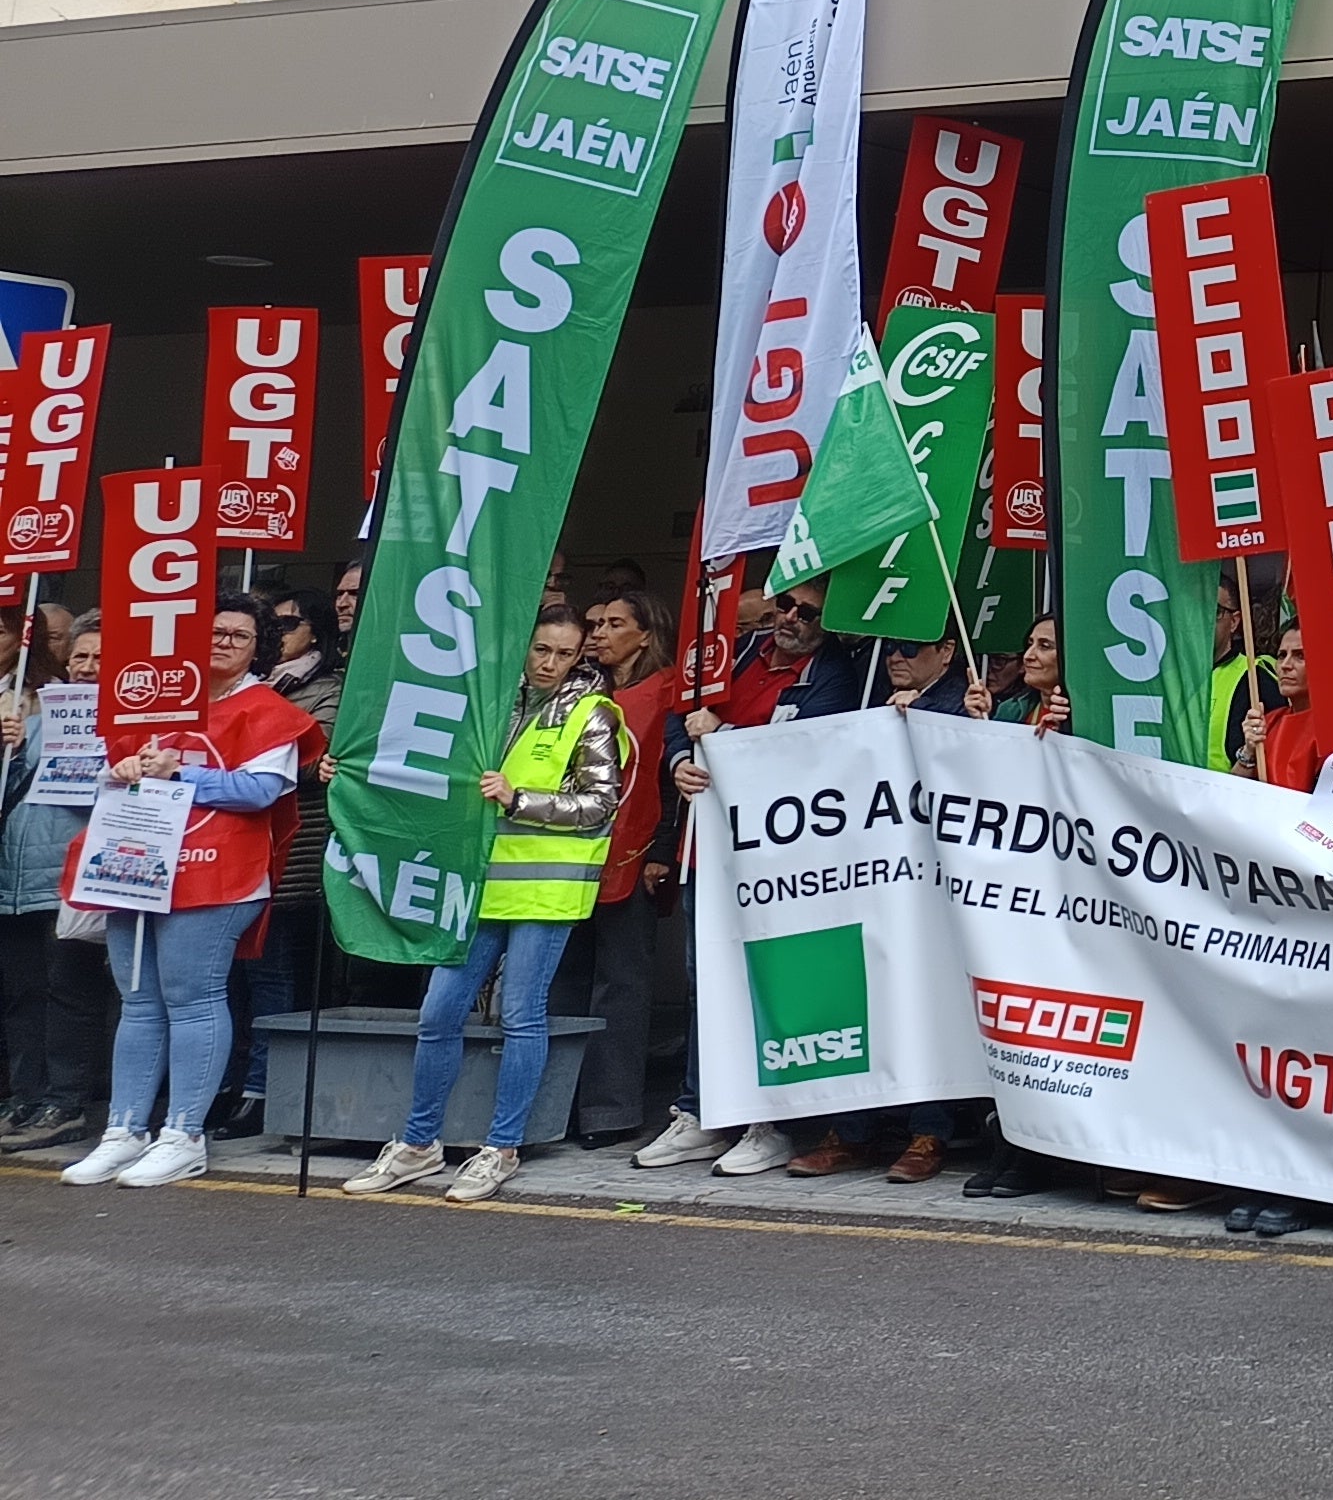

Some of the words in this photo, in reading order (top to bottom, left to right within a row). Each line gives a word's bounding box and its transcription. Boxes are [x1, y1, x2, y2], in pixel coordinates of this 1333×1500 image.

[539, 35, 671, 100] SATSE
[1119, 15, 1271, 68] SATSE
[1106, 91, 1257, 146] JAÉN
[513, 119, 646, 174] JAÉN
[917, 130, 999, 291] UGT
[1182, 197, 1256, 459] CCOO
[907, 346, 988, 380] CSIF
[26, 338, 96, 502] UGT
[229, 319, 301, 479] UGT
[367, 227, 581, 800] SATSE
[1216, 529, 1266, 550] Jaén
[128, 479, 201, 656] UGT
[162, 670, 186, 683] FSP
[50, 709, 68, 719] NO
[730, 787, 848, 851] LOS
[1108, 824, 1209, 892] SON
[735, 857, 923, 908] CONSEJERA:
[1010, 886, 1048, 917] EL
[1055, 893, 1159, 942] ACUERDO
[1164, 920, 1196, 952] DE
[1203, 926, 1332, 972] PRIMARIA
[976, 990, 1100, 1044] CCOO
[762, 1026, 864, 1071] SATSE
[1000, 1048, 1051, 1070] sanidad
[1051, 1060, 1063, 1073] y
[1066, 1060, 1129, 1080] sectores
[1007, 1072, 1021, 1086] de
[1023, 1075, 1093, 1098] Andalucía
